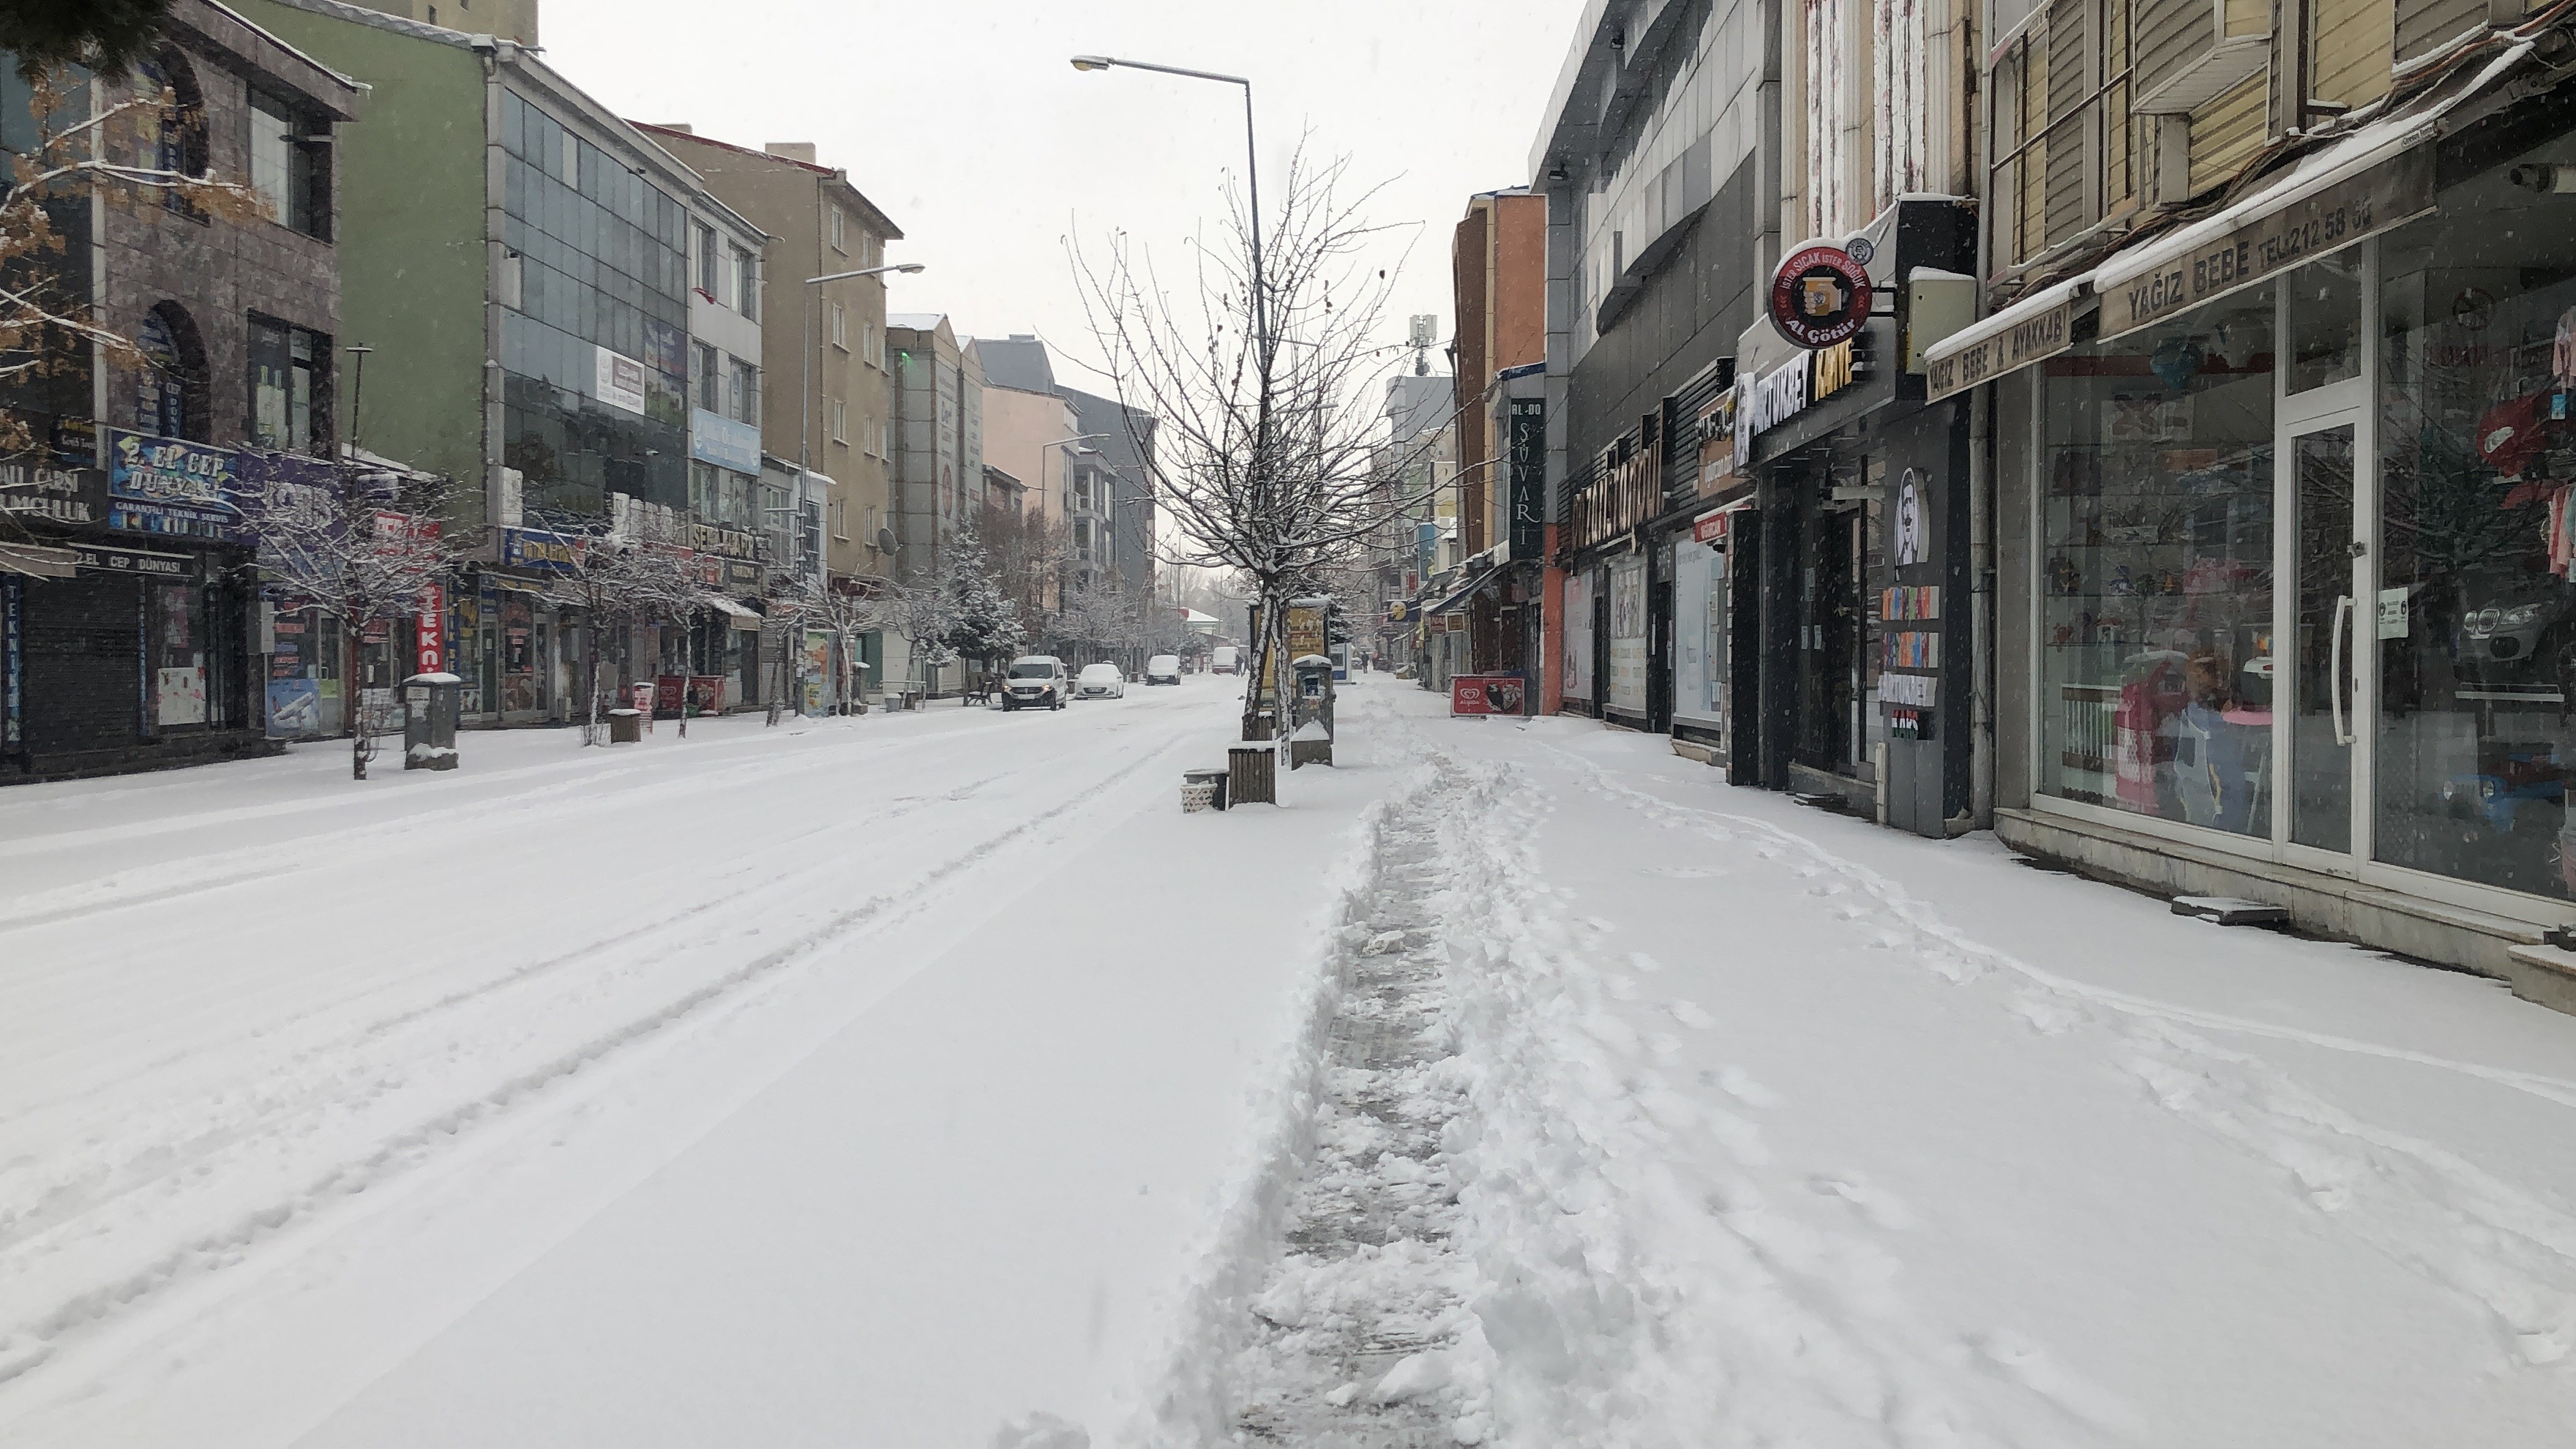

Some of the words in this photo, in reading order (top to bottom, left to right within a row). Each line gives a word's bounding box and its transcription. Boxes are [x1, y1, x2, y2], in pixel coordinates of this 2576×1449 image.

[1793, 252, 1821, 271] SICAK
[2129, 270, 2184, 321] YAĞIZ
[2195, 240, 2249, 293] BEBE
[1963, 343, 1988, 382] BEBE
[154, 446, 176, 470] EL
[187, 452, 225, 477] CEP
[111, 555, 130, 568] CEP
[138, 558, 181, 573] DÜNYASI
